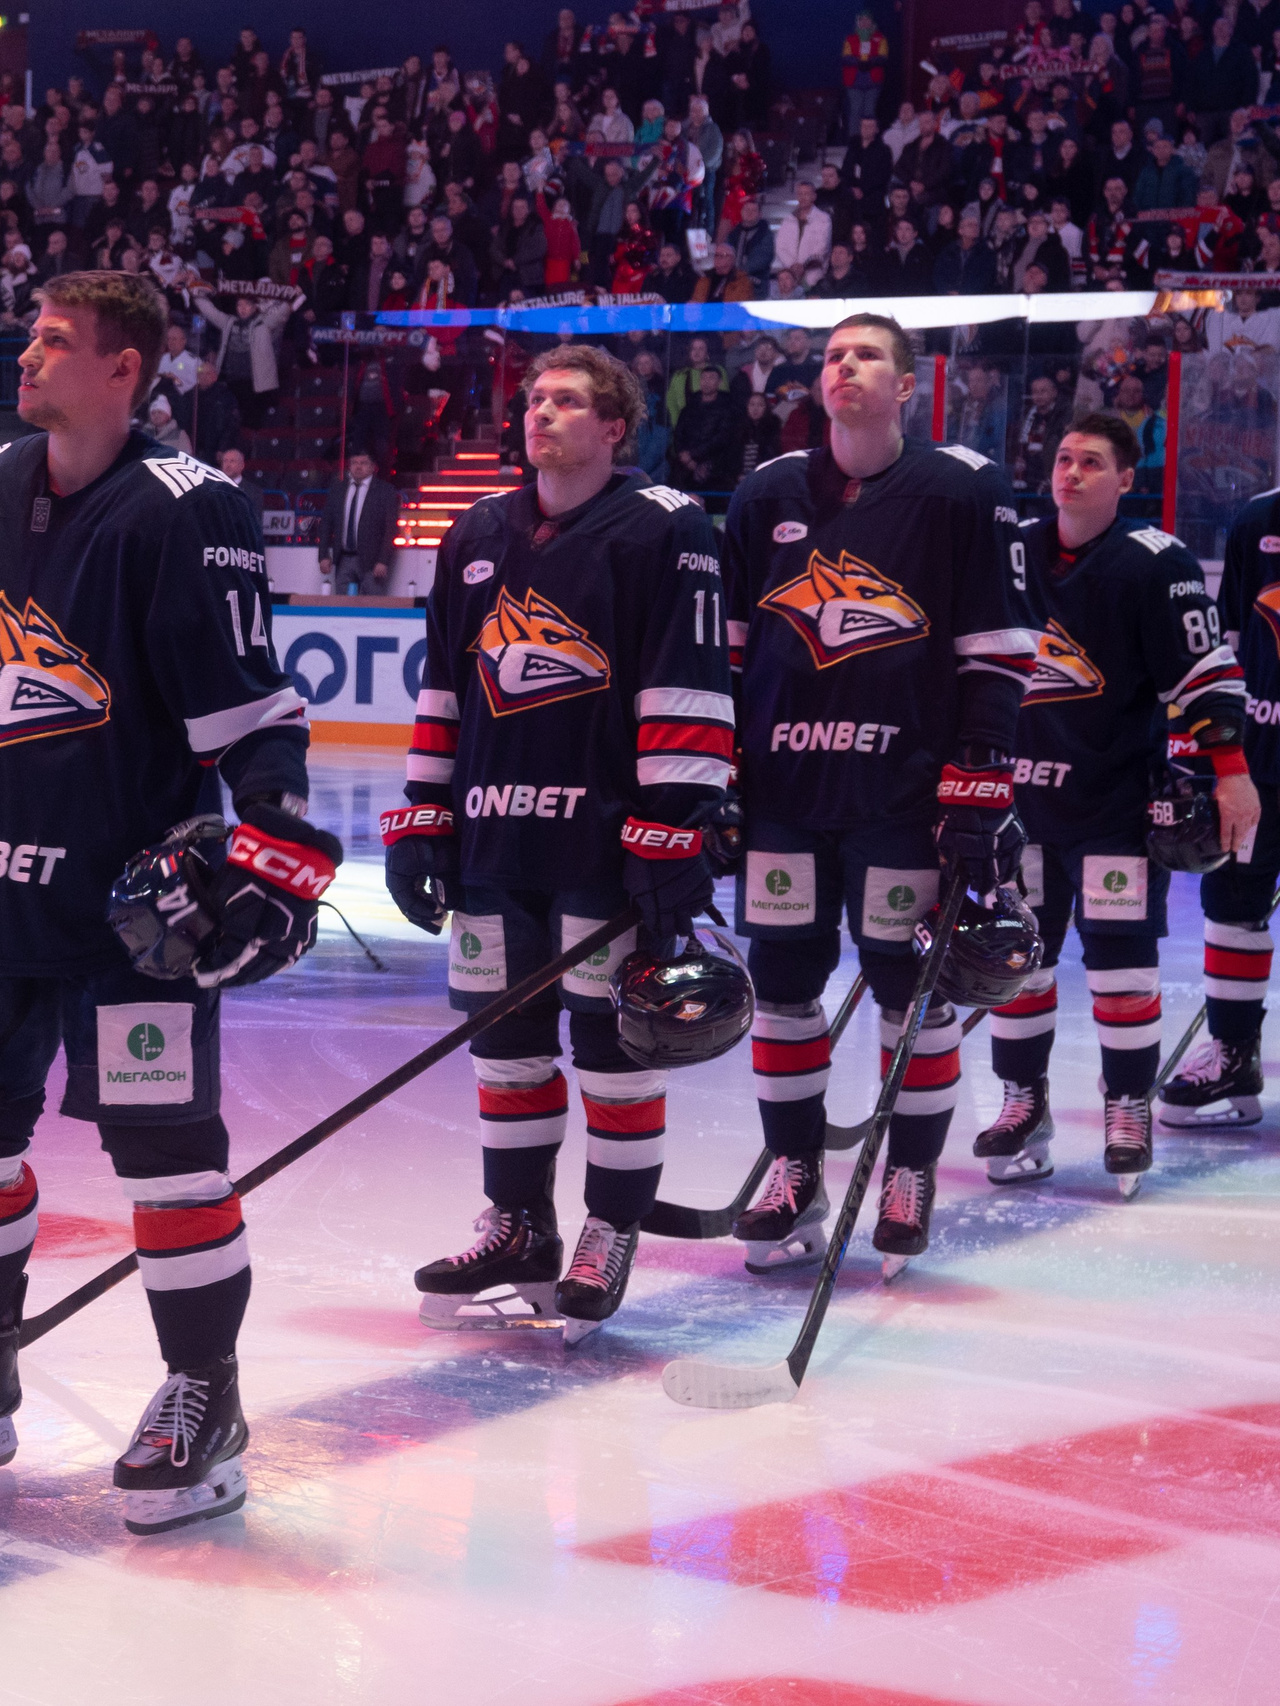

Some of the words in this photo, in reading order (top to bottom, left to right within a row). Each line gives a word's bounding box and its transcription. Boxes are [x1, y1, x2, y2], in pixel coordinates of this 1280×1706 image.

[203, 546, 265, 574] FONBET
[1010, 542, 1026, 591] 9
[226, 590, 270, 658] 14
[694, 590, 720, 647] 11
[1182, 604, 1220, 655] 89
[771, 721, 901, 754] FONBET
[229, 834, 332, 896] CCM
